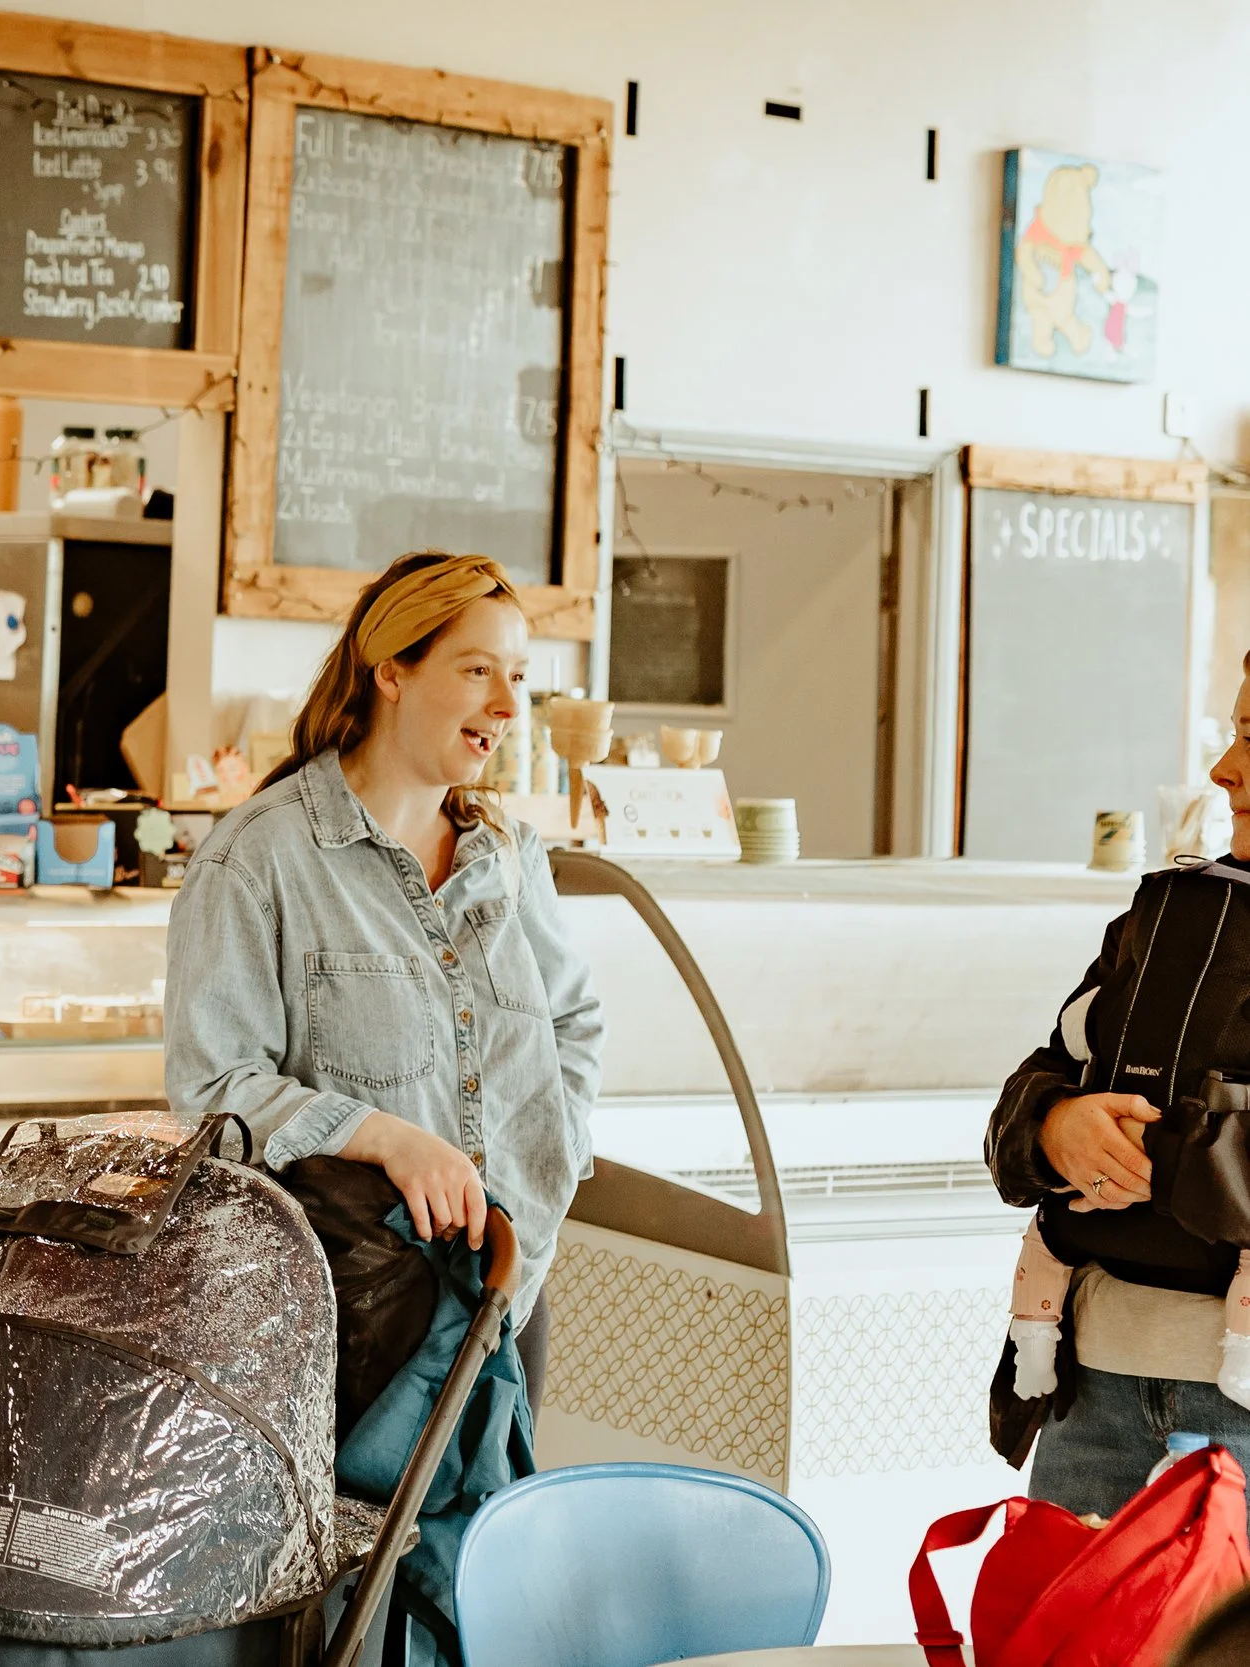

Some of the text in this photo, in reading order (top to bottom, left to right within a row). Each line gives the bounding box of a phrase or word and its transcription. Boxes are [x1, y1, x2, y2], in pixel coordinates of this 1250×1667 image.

[1019, 501, 1147, 562] SPECIALS
[50, 1508, 70, 1519] MISE
[70, 1513, 81, 1523] EN
